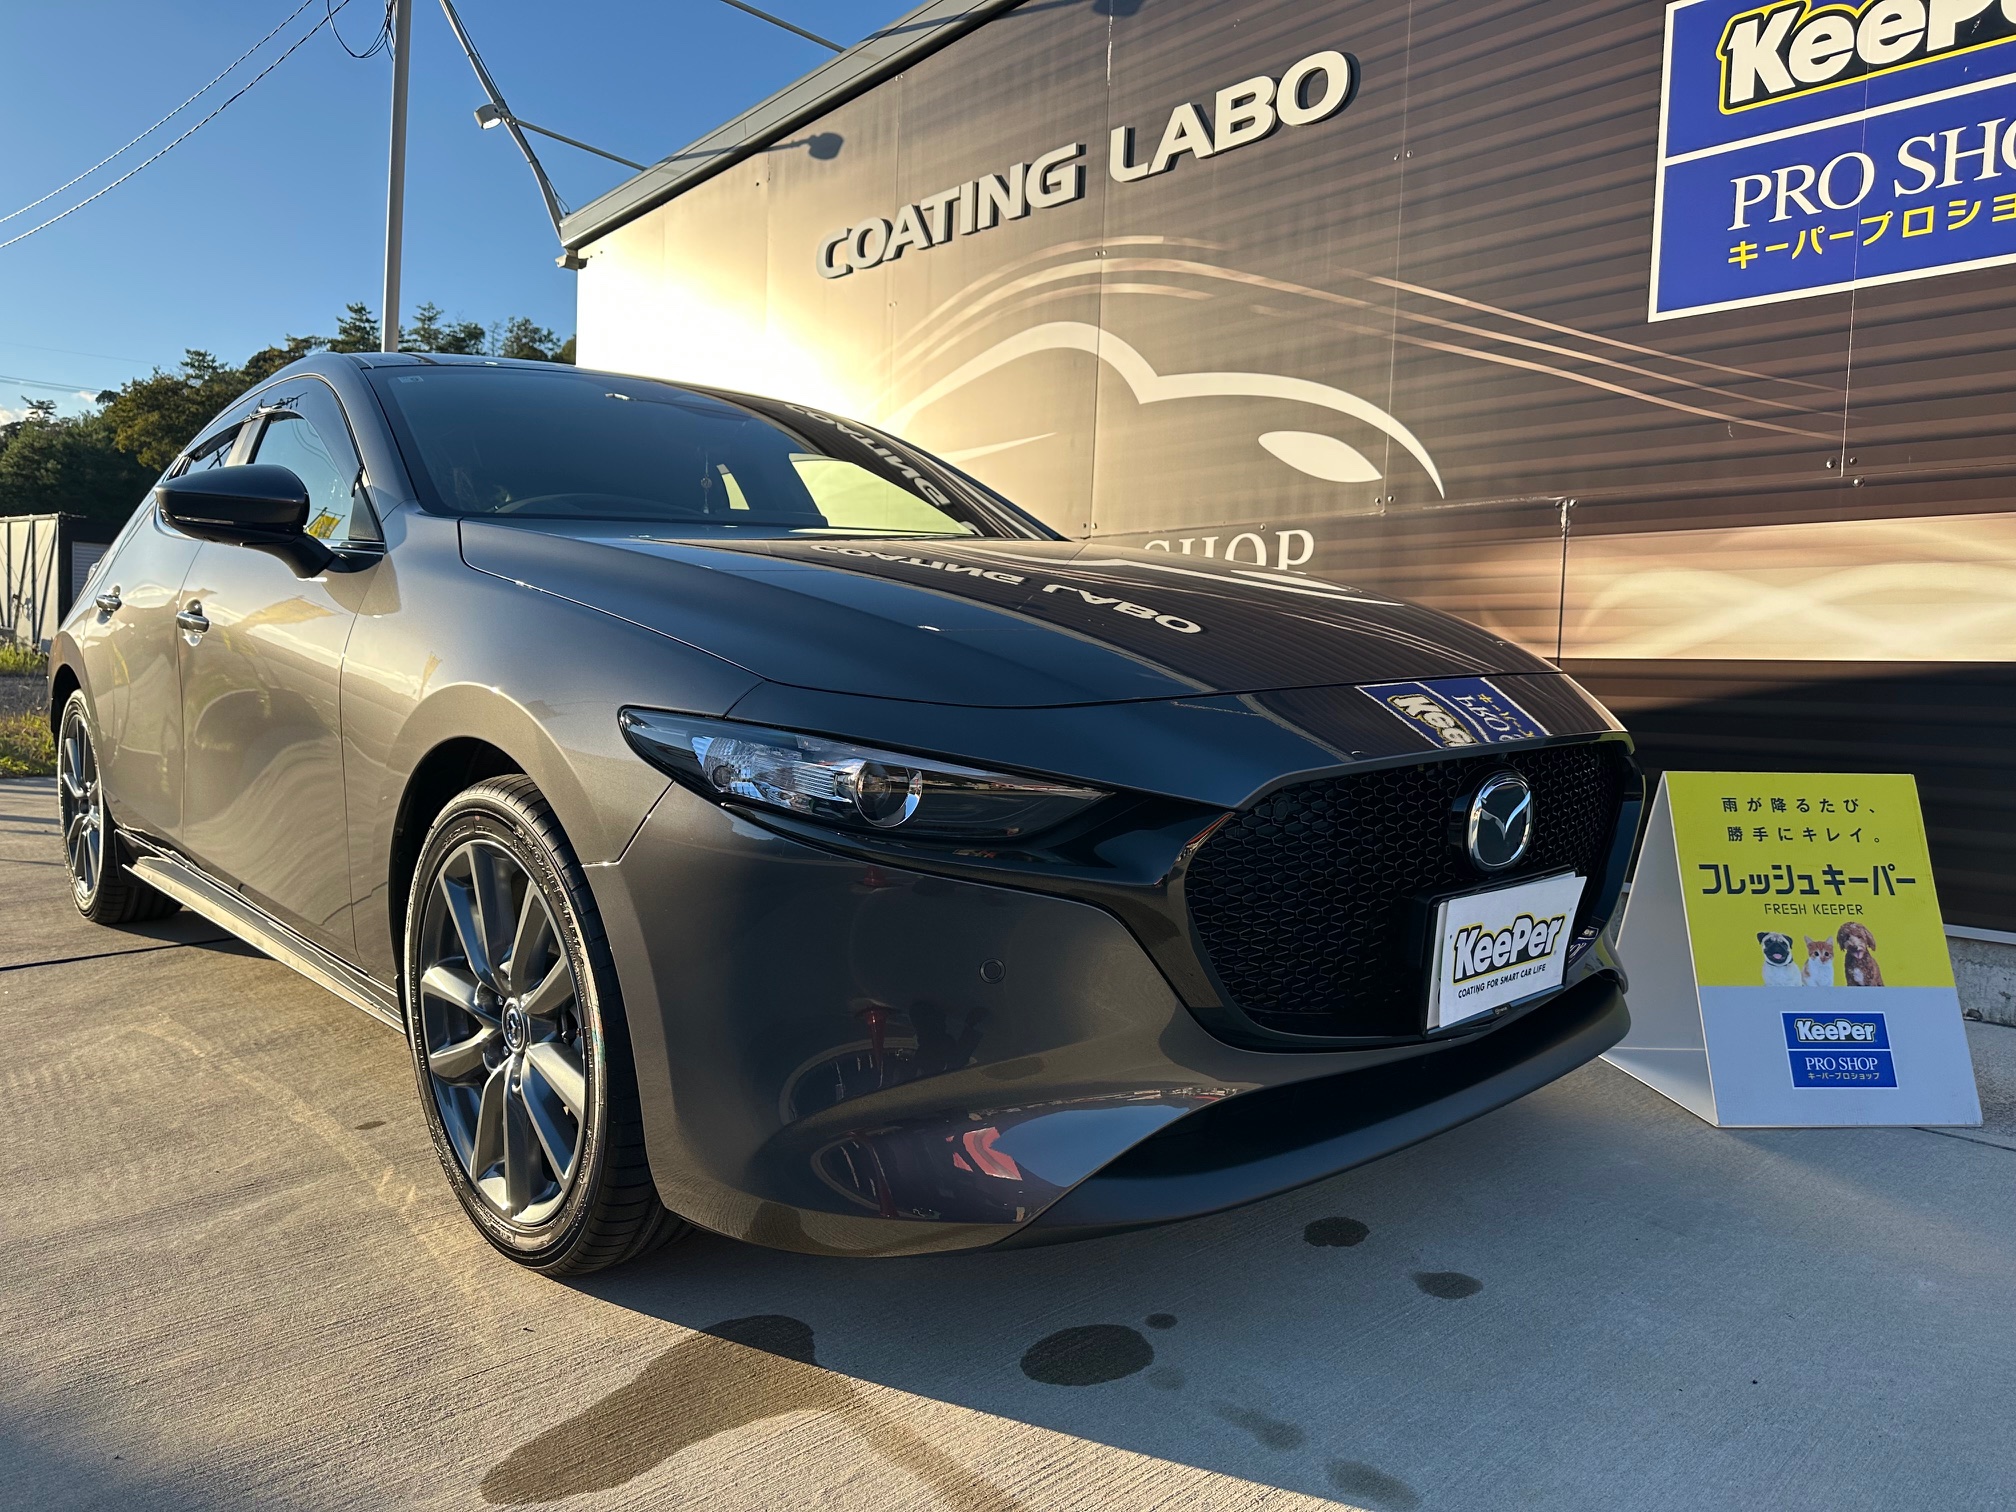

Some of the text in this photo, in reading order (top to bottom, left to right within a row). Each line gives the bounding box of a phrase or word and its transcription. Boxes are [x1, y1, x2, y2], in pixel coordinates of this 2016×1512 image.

[1724, 0, 2016, 104] KeeP
[816, 50, 1351, 279] COATING LABO
[1727, 118, 2016, 231] PRO SH
[1721, 797, 1876, 814] 雨が降るたび、
[1727, 826, 1880, 842] 勝手にキレイ。
[1698, 863, 1916, 896] フレッシュキーパー
[1764, 903, 1864, 915] FRESH KEEPER
[1454, 915, 1564, 982] KeePer
[1457, 963, 1546, 998] COATING FOR SMART CAR LIFE
[1796, 1019, 1875, 1041] KeePer
[1805, 1057, 1878, 1071] PRO SHOP
